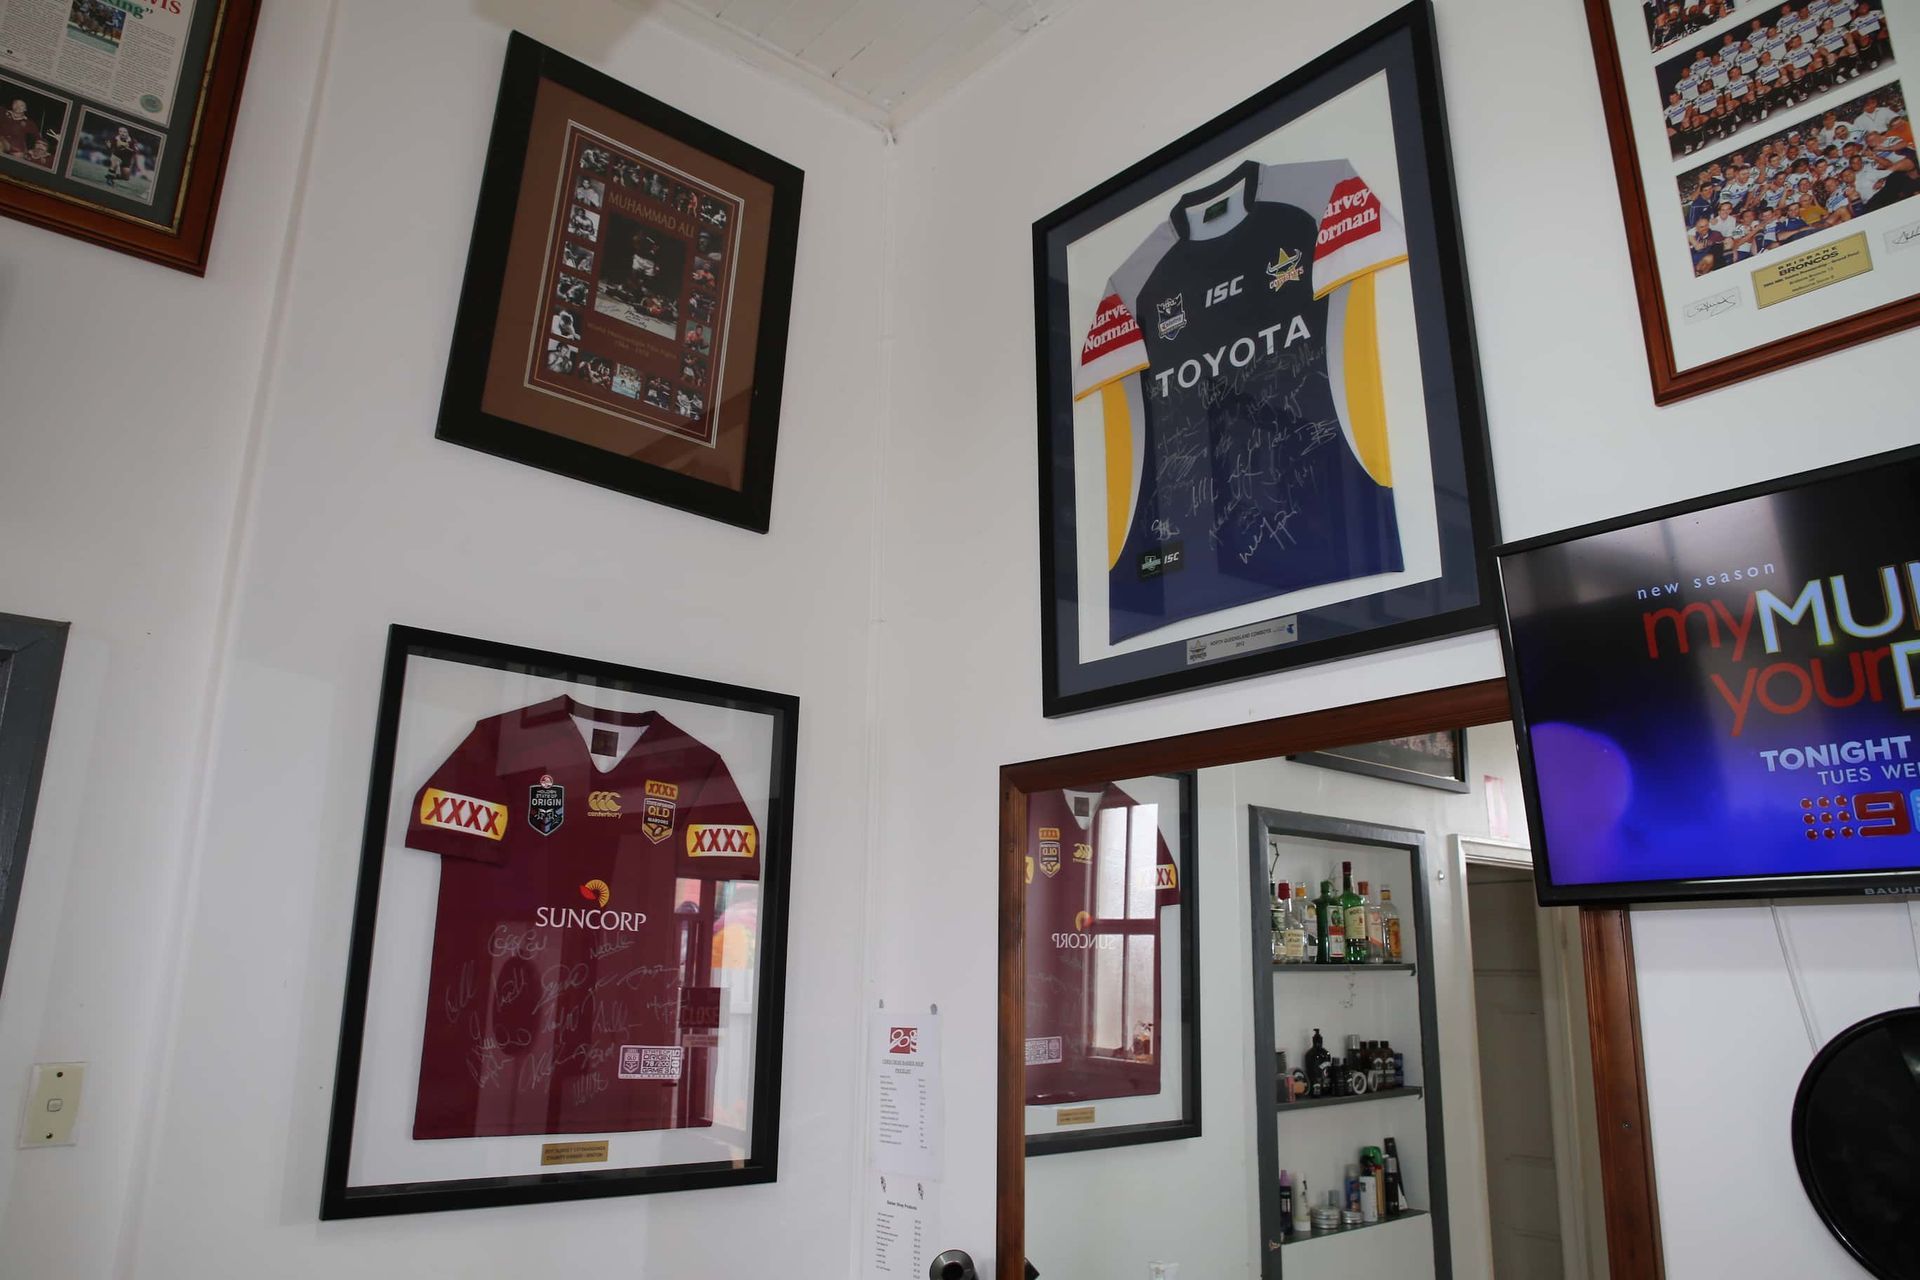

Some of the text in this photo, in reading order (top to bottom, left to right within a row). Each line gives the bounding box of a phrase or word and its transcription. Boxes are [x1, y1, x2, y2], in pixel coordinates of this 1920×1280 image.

[608, 191, 695, 238] MUHAMMAD ALI
[1321, 187, 1372, 220] arvey
[1315, 206, 1378, 246] orman
[1777, 246, 1838, 271] BRISBANE
[1778, 250, 1840, 277] BRONCOS
[1205, 275, 1245, 308] ISC
[1155, 314, 1312, 398] TOYOTA
[1163, 551, 1180, 565] ISC
[1637, 563, 1776, 600] new season
[1760, 735, 1912, 772] TONIGHT
[1817, 763, 1920, 786] TUES WE
[531, 798, 562, 807] ORIGIN
[587, 811, 623, 820] canterbury
[648, 805, 670, 818] QLD
[424, 796, 501, 837] XXXX
[690, 828, 753, 854] XXXX
[535, 905, 647, 932] SUNCORP
